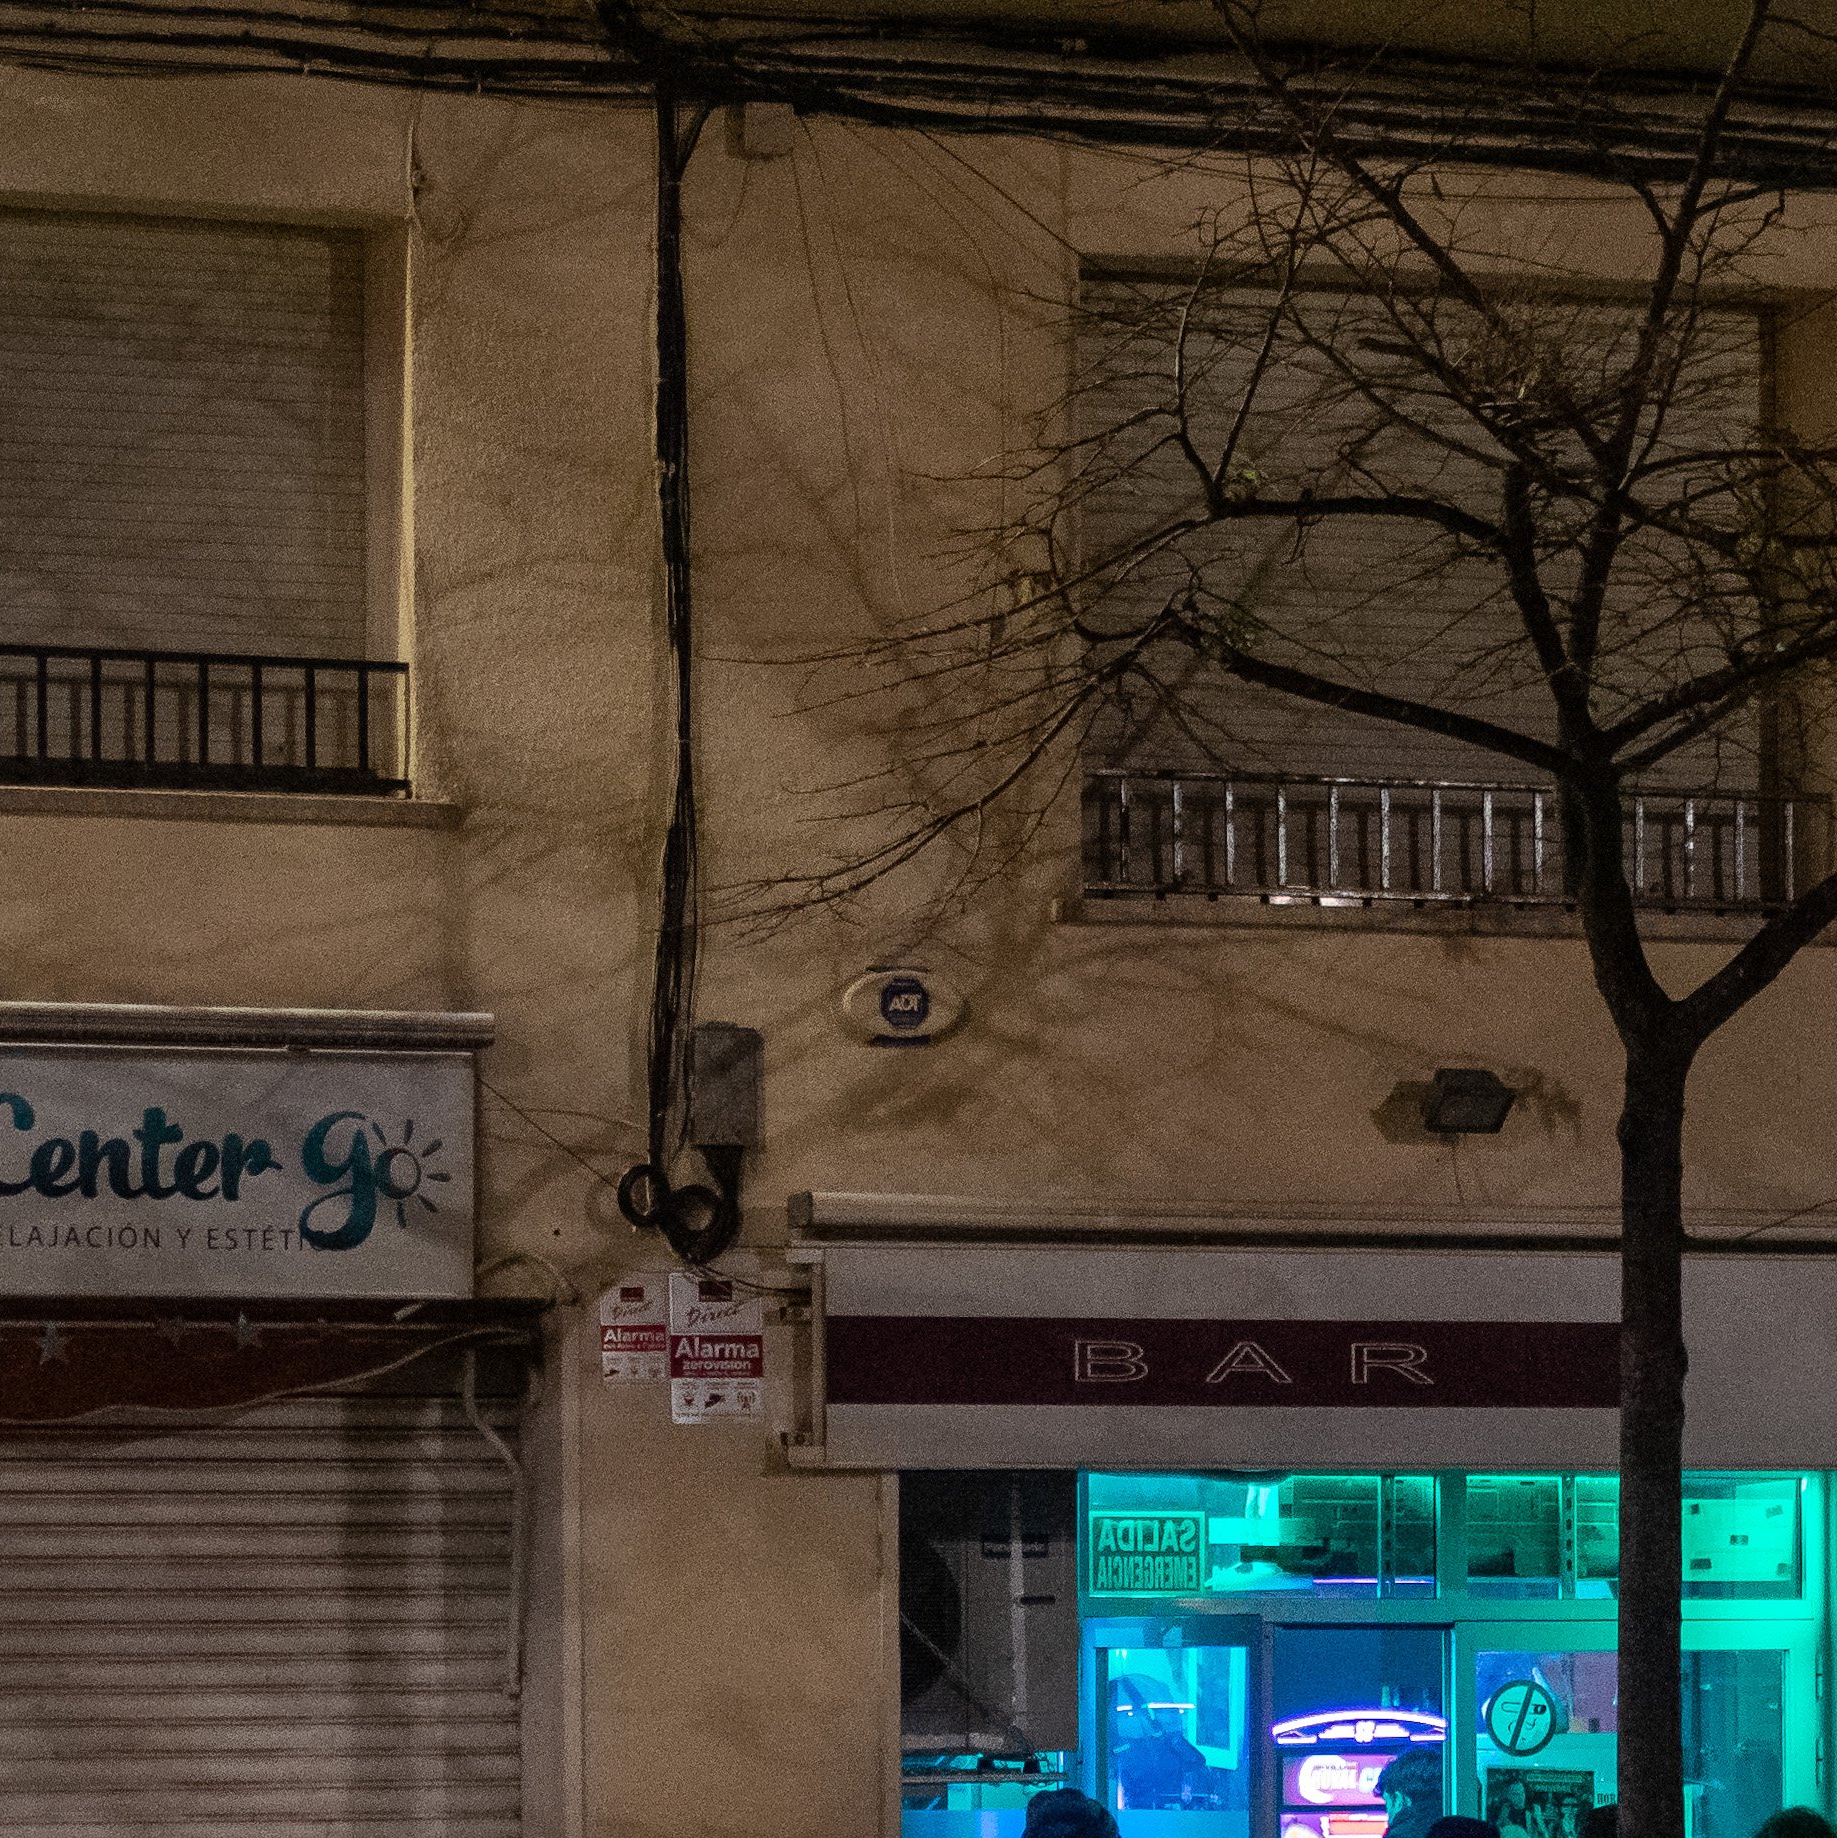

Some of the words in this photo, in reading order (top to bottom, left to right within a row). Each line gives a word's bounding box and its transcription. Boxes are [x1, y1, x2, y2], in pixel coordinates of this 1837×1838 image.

[888, 993, 921, 1012] ADT
[175, 1226, 192, 1249] Y
[206, 1224, 325, 1252] ESTÉTI
[603, 1328, 666, 1343] Alarma
[674, 1336, 760, 1359] Alarma
[1074, 1339, 1435, 1385] BAR
